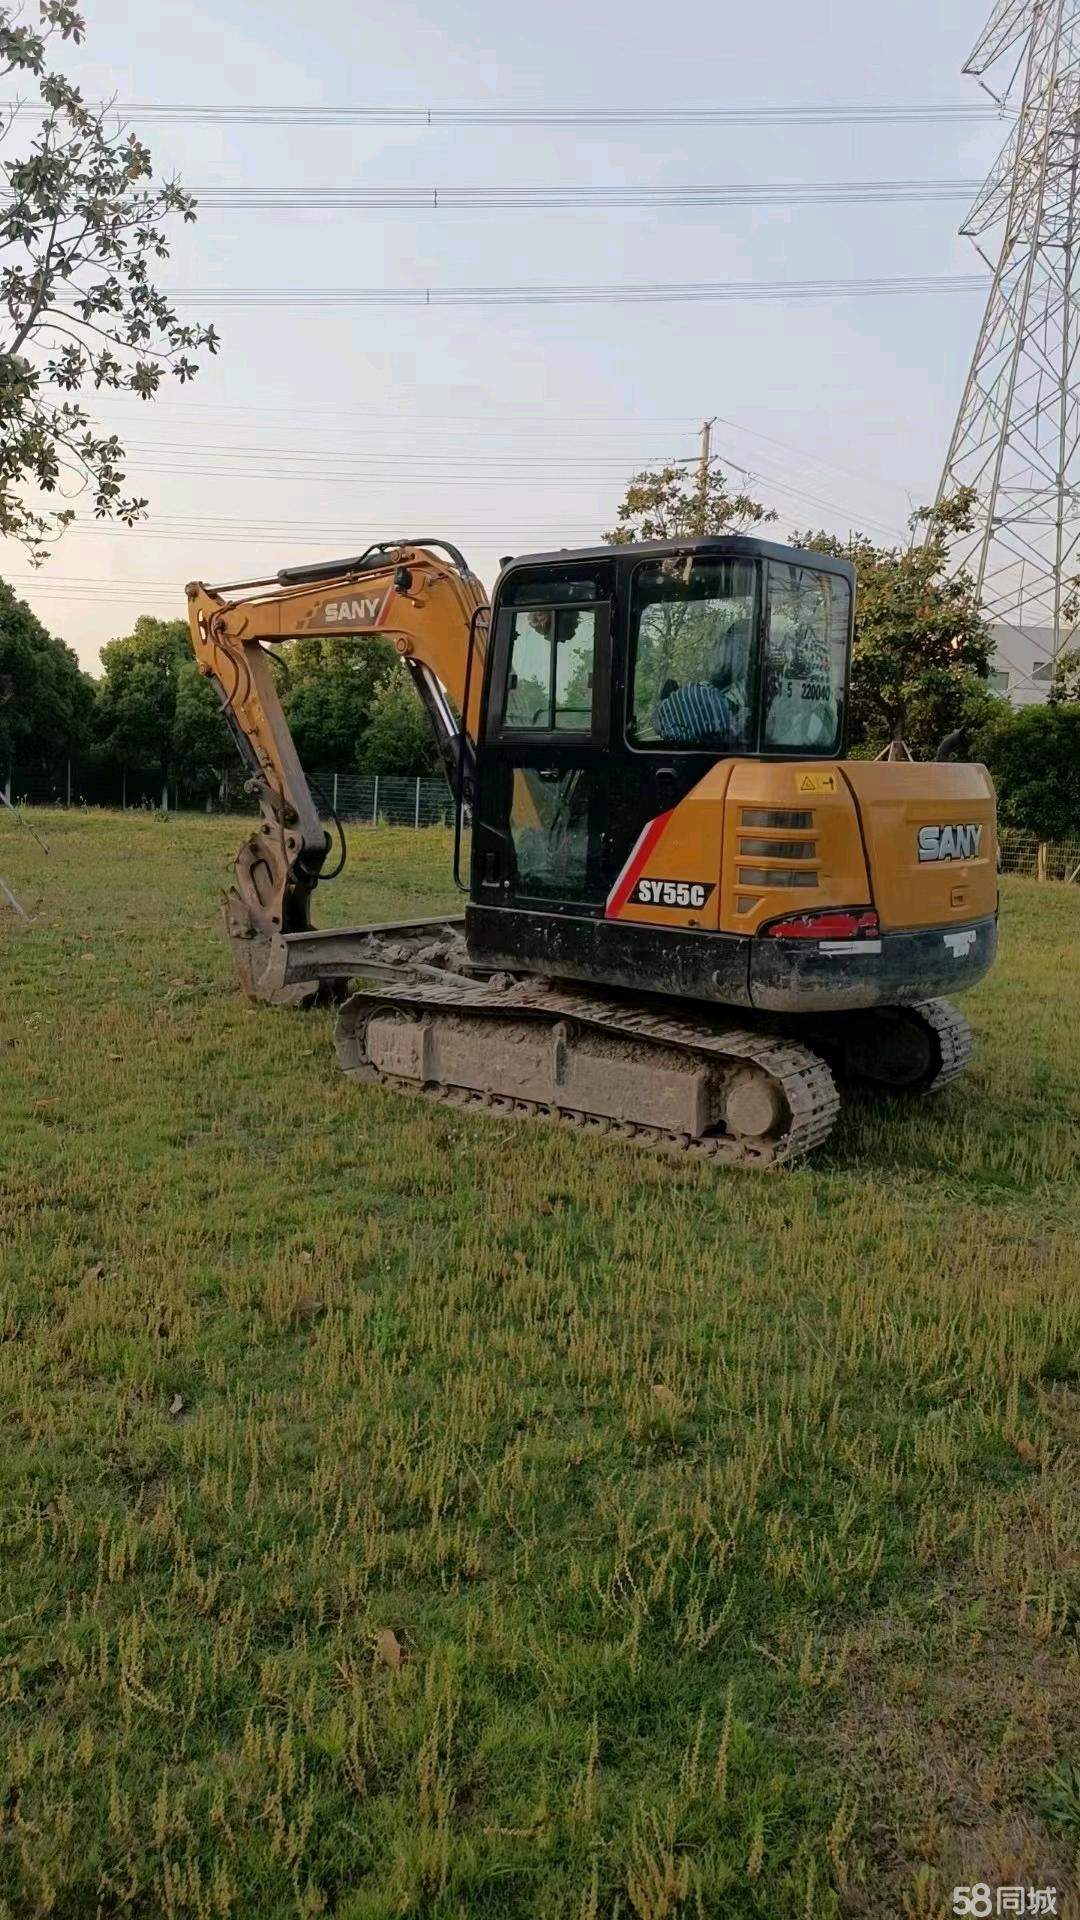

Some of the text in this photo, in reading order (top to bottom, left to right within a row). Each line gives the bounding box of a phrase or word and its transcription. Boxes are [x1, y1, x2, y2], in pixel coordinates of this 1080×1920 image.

[325, 598, 380, 622] SANY
[918, 823, 983, 862] SANY
[638, 880, 705, 907] SY55C
